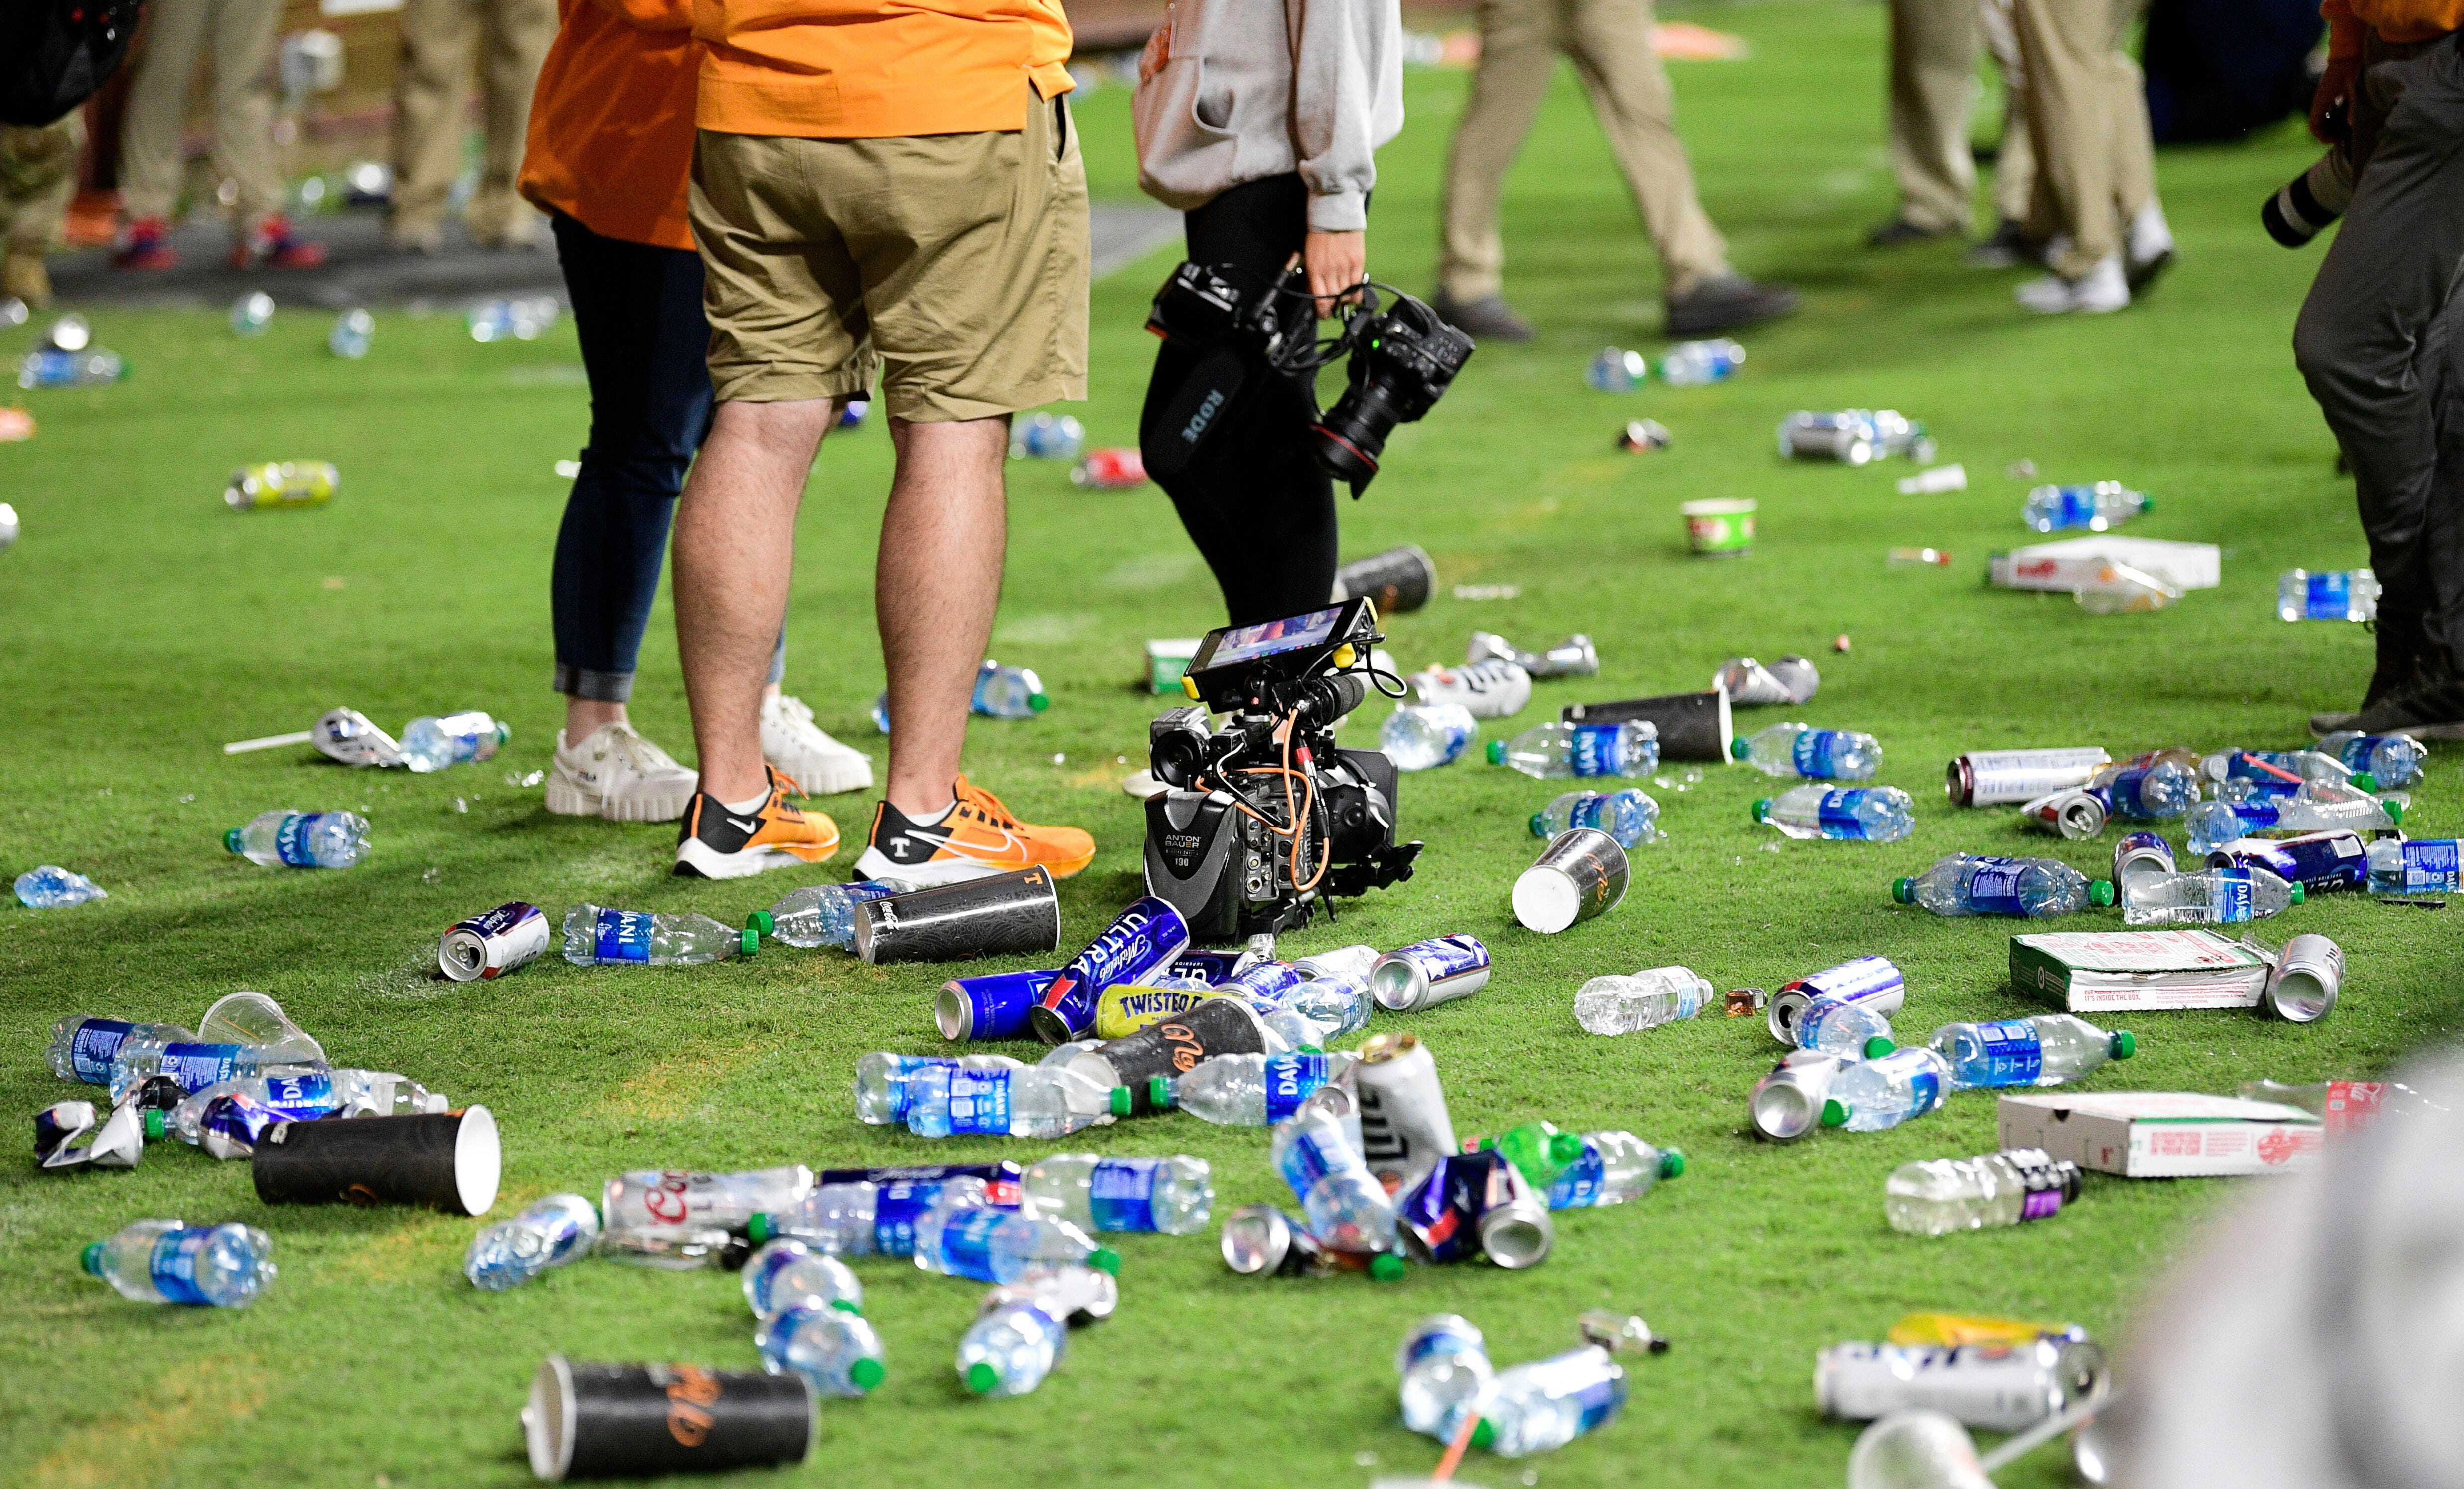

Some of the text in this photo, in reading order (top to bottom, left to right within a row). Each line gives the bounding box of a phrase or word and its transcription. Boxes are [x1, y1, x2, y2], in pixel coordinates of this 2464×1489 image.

[889, 837, 911, 857] T
[1175, 858, 1189, 866] 190
[1024, 872, 1043, 884] T
[1069, 913, 1149, 975] ULTRA
[1099, 934, 1146, 985] Michelob
[1119, 992, 1189, 1018] TWISTED
